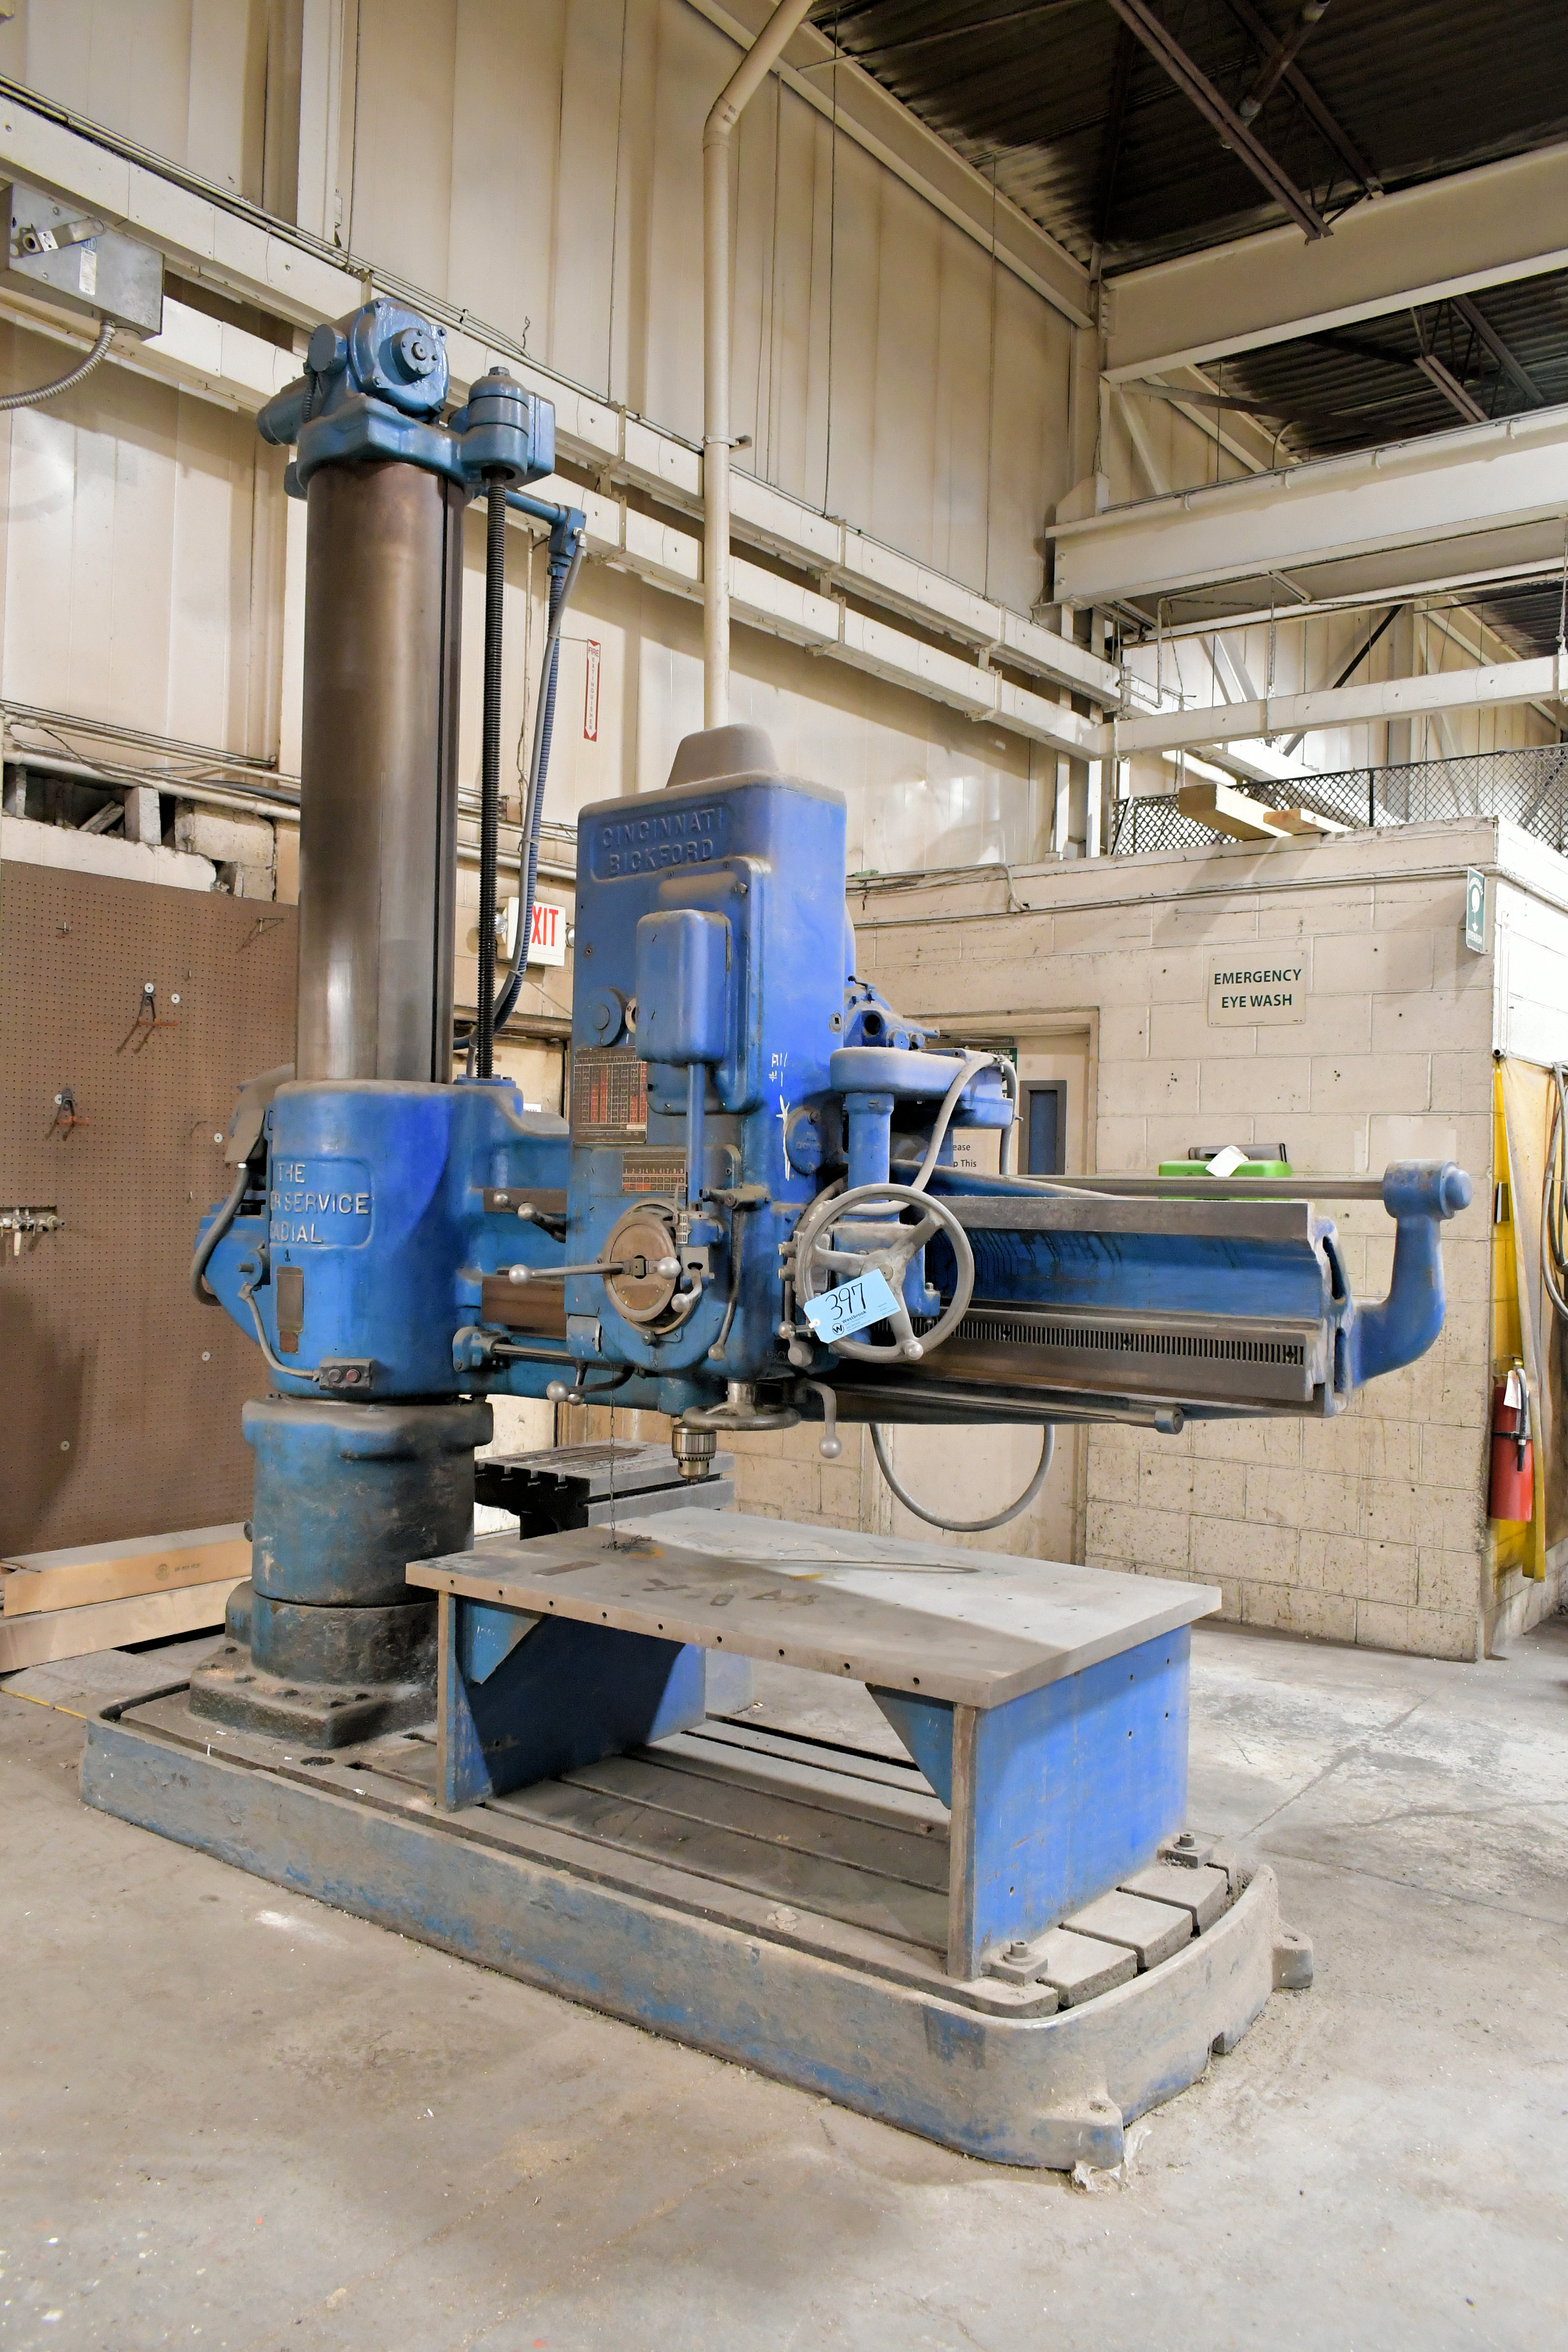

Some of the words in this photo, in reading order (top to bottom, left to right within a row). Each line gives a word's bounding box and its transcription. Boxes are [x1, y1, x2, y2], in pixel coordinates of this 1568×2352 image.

[588, 647, 599, 657] FIRE
[602, 807, 723, 848] CINCINNATI
[608, 839, 714, 876] BICKFORD
[531, 905, 559, 947] XIT
[1214, 969, 1302, 985] EMERGENCY
[1222, 996, 1246, 1008] EYE
[1250, 994, 1292, 1007] WASH
[278, 1162, 306, 1183] THE
[960, 1159, 977, 1168] This
[284, 1192, 370, 1214] SERVICE
[825, 1282, 866, 1320] 397
[841, 1310, 867, 1324] Westbrook
